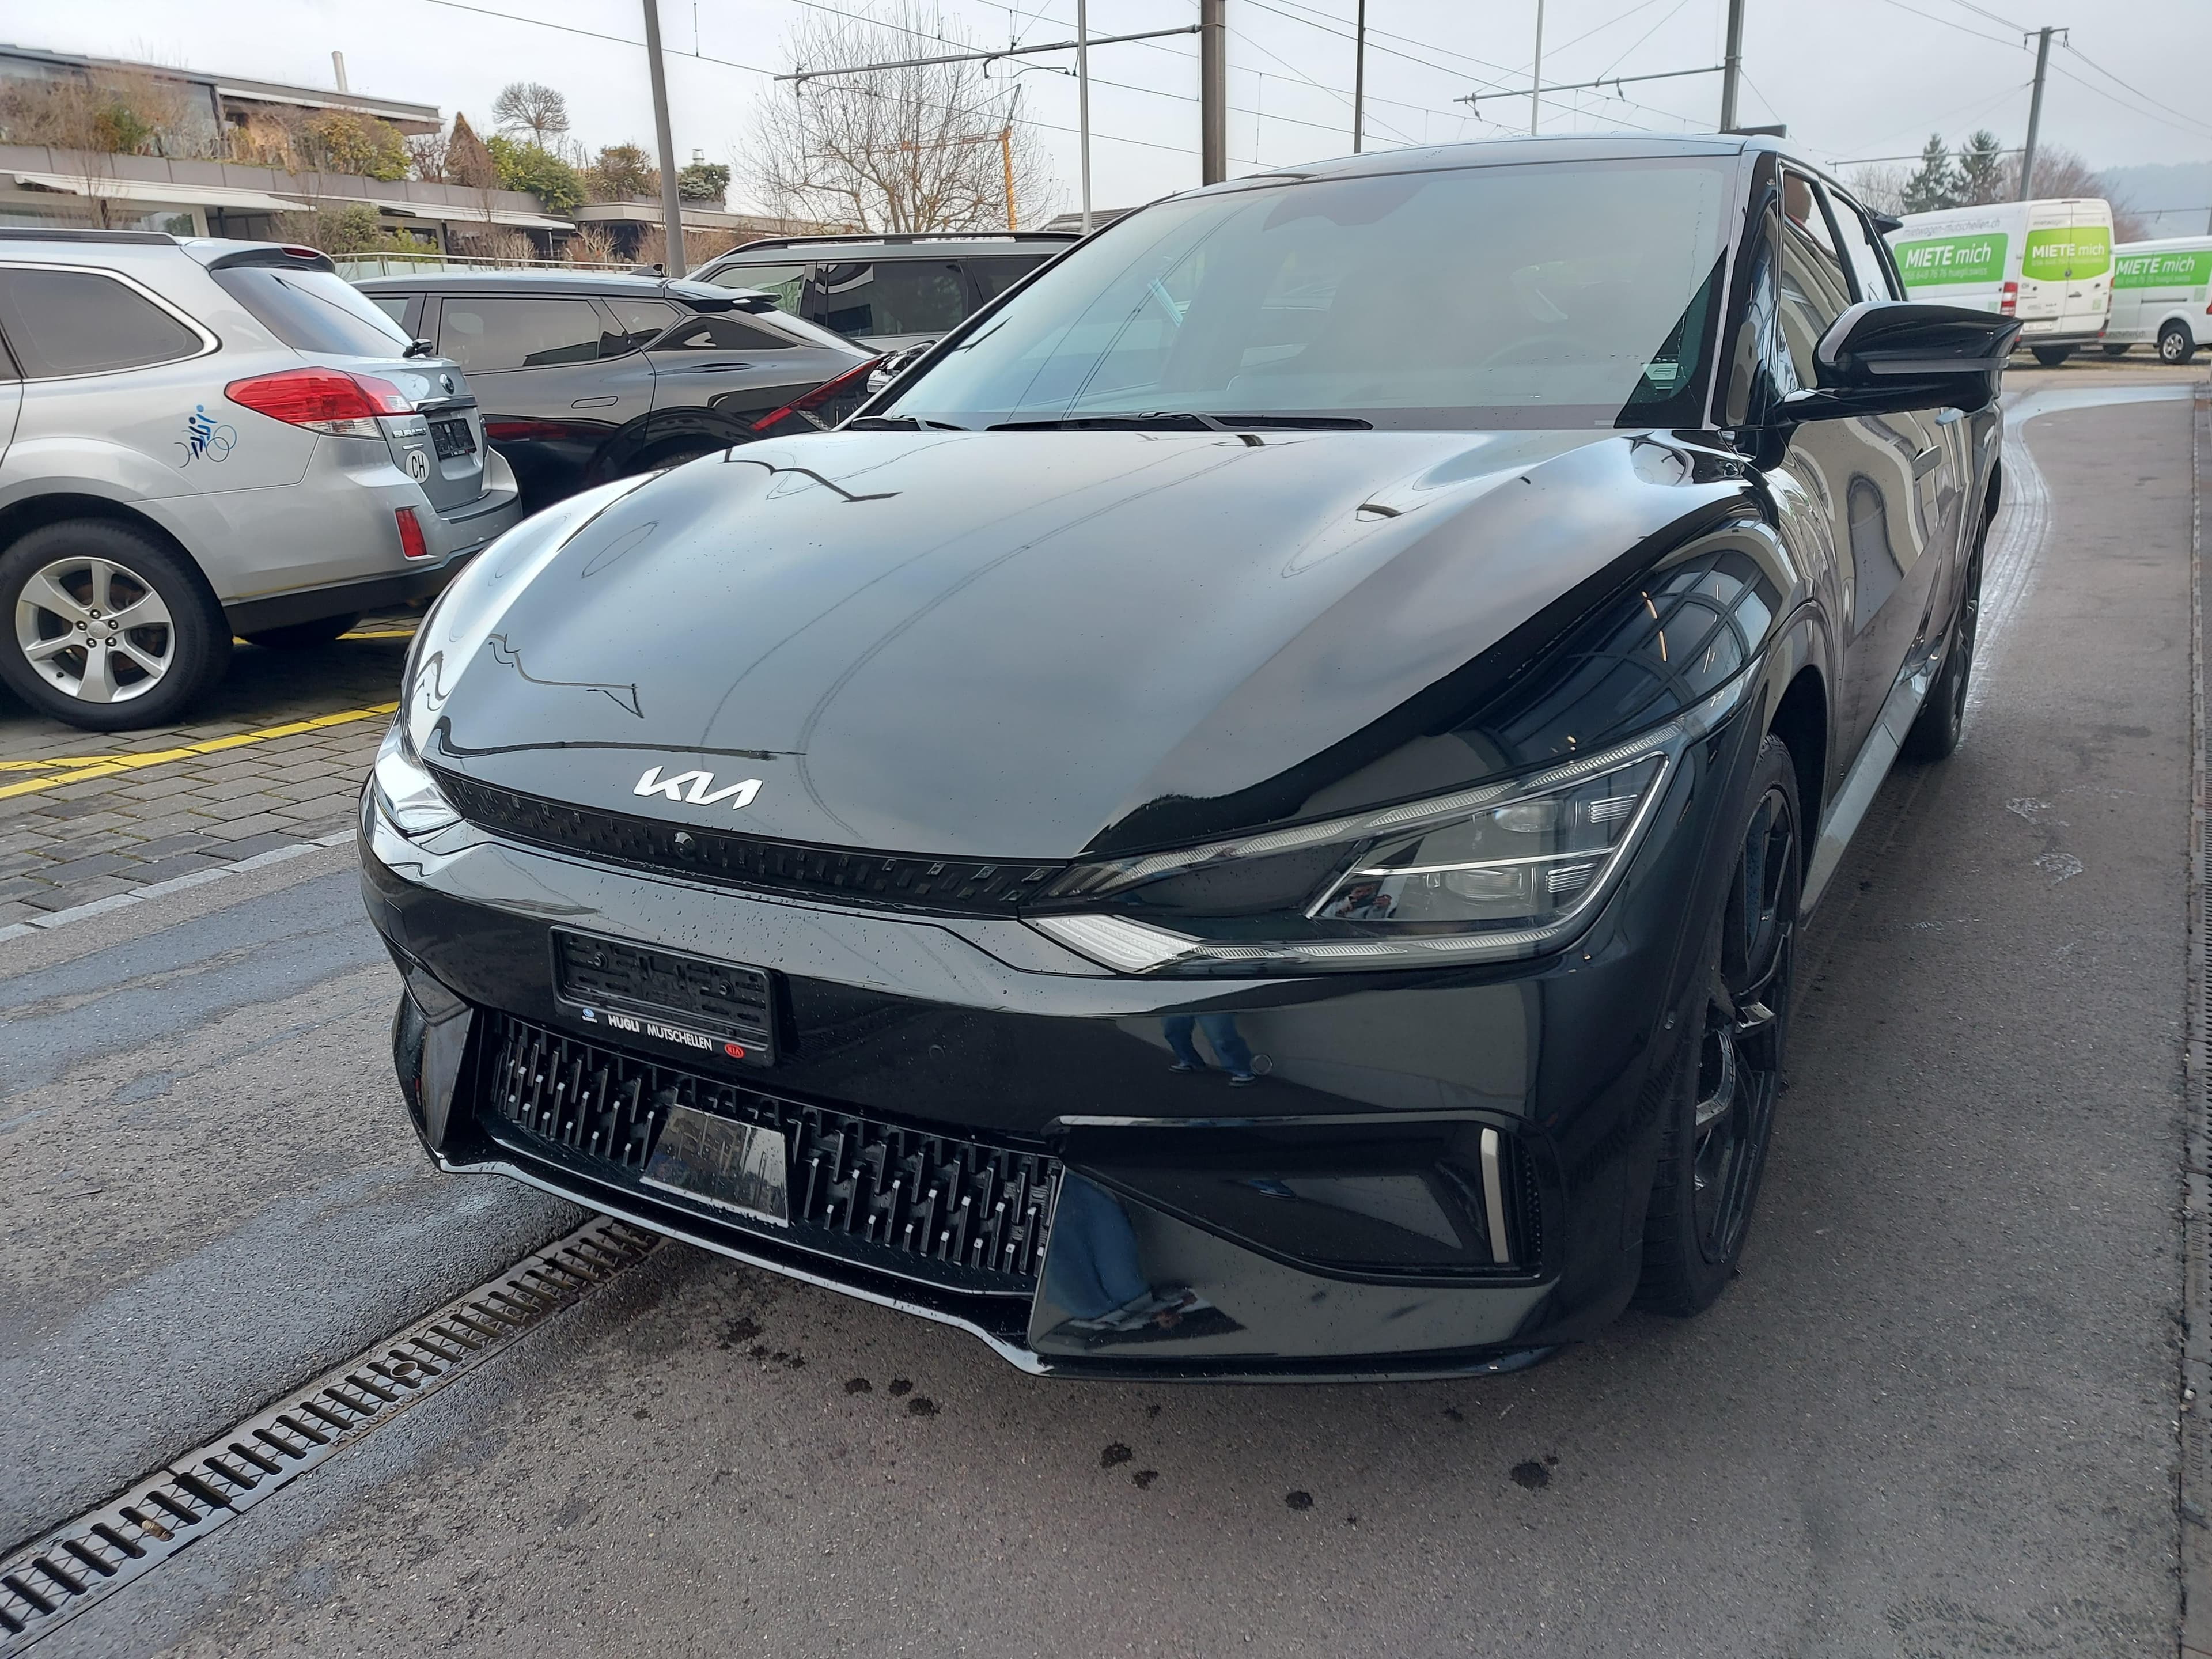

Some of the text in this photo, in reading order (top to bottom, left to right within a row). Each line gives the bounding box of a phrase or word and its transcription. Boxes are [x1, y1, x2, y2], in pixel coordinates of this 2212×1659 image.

[1906, 242, 1991, 268] MIETE mich
[2032, 243, 2104, 259] MIETE mich
[2116, 257, 2161, 275] MIETE
[2162, 256, 2195, 272] mich
[412, 454, 426, 479] CH
[633, 765, 763, 811] KIA
[647, 1024, 713, 1051] MUTSCHELLEN
[726, 1046, 742, 1055] KIA
[343, 1389, 425, 1438] hauraton
